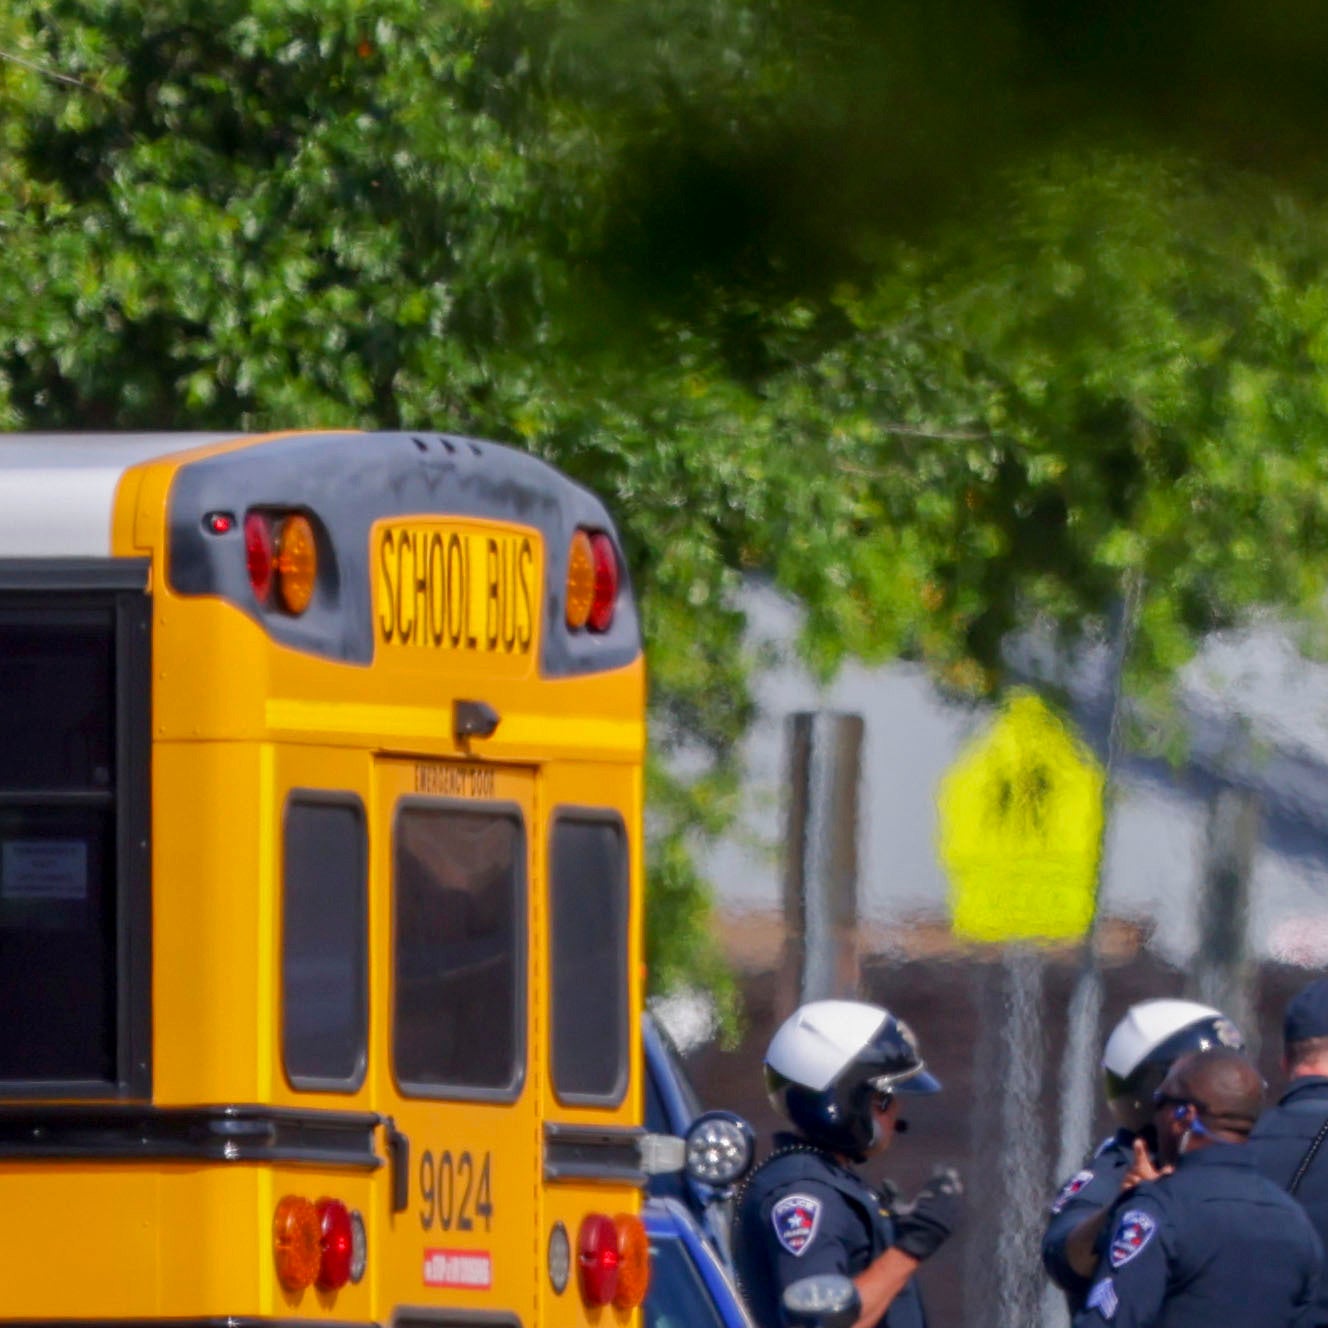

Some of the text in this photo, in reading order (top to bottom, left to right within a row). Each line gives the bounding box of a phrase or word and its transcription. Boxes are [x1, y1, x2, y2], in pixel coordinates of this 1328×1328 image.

[380, 529, 532, 653] SCHOOL BUS
[419, 1150, 493, 1232] 9024
